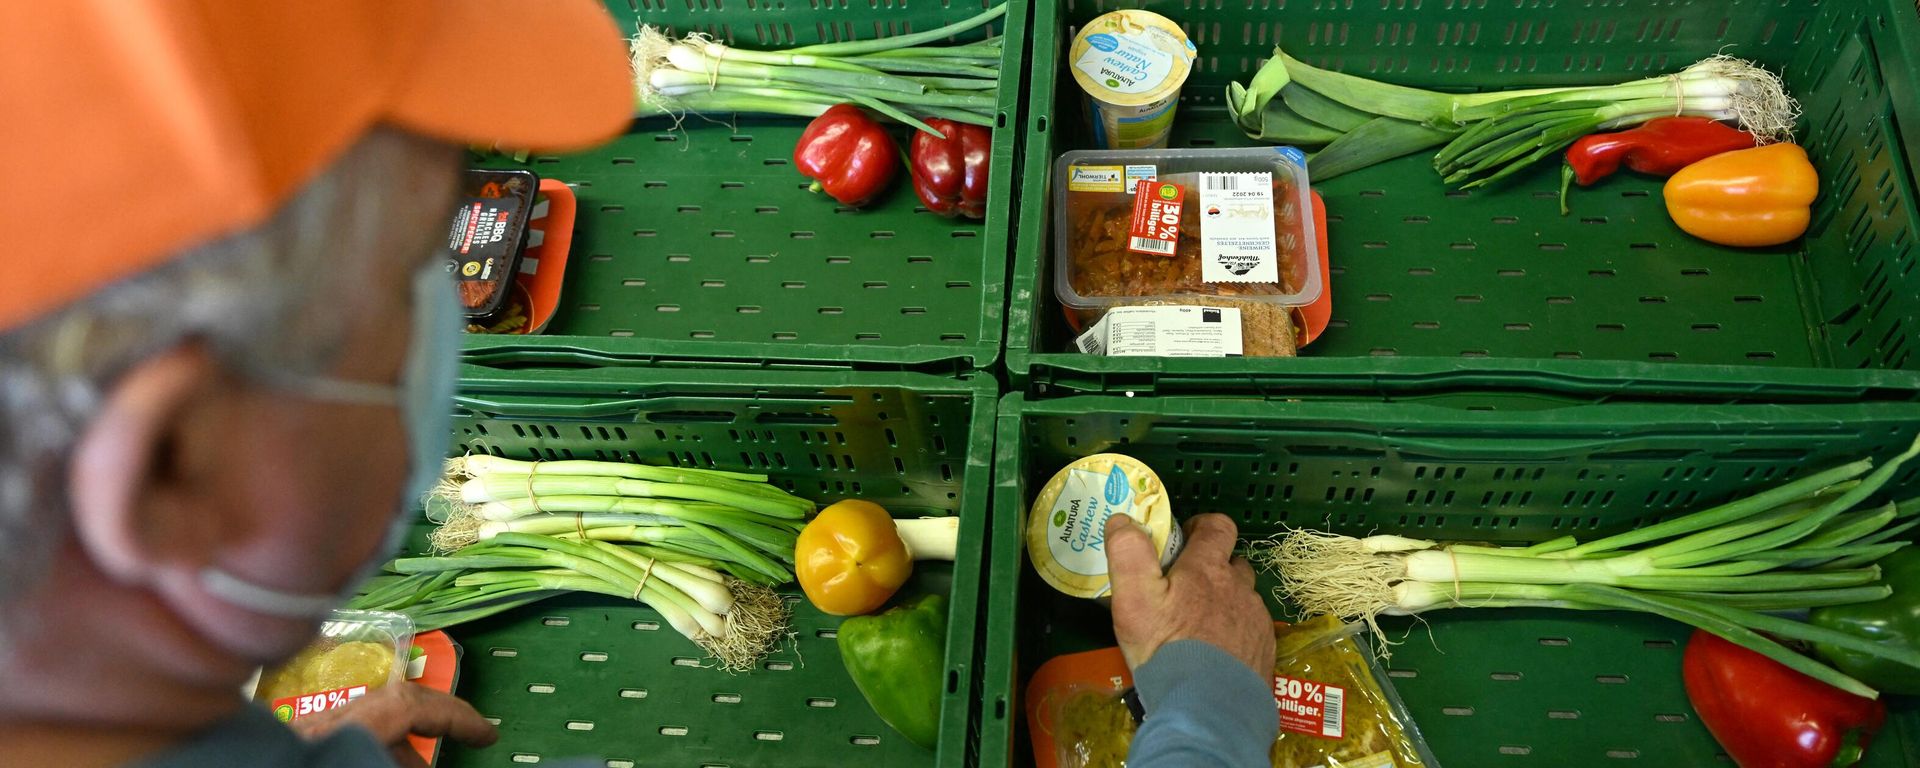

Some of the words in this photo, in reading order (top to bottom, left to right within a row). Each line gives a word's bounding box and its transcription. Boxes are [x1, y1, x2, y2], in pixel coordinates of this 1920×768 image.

[1103, 56, 1148, 81] Cashew
[1114, 49, 1152, 71] Natur
[1100, 66, 1136, 87] ALNATURA
[470, 204, 482, 225] SPICY
[1147, 202, 1162, 237] billiger.
[461, 225, 476, 252] PEPPER
[472, 212, 489, 245] GRILLIES
[489, 221, 507, 243] BBQ
[1060, 499, 1081, 543] ALNATURA
[1071, 496, 1098, 552] Cashew
[1087, 504, 1113, 552] Natur
